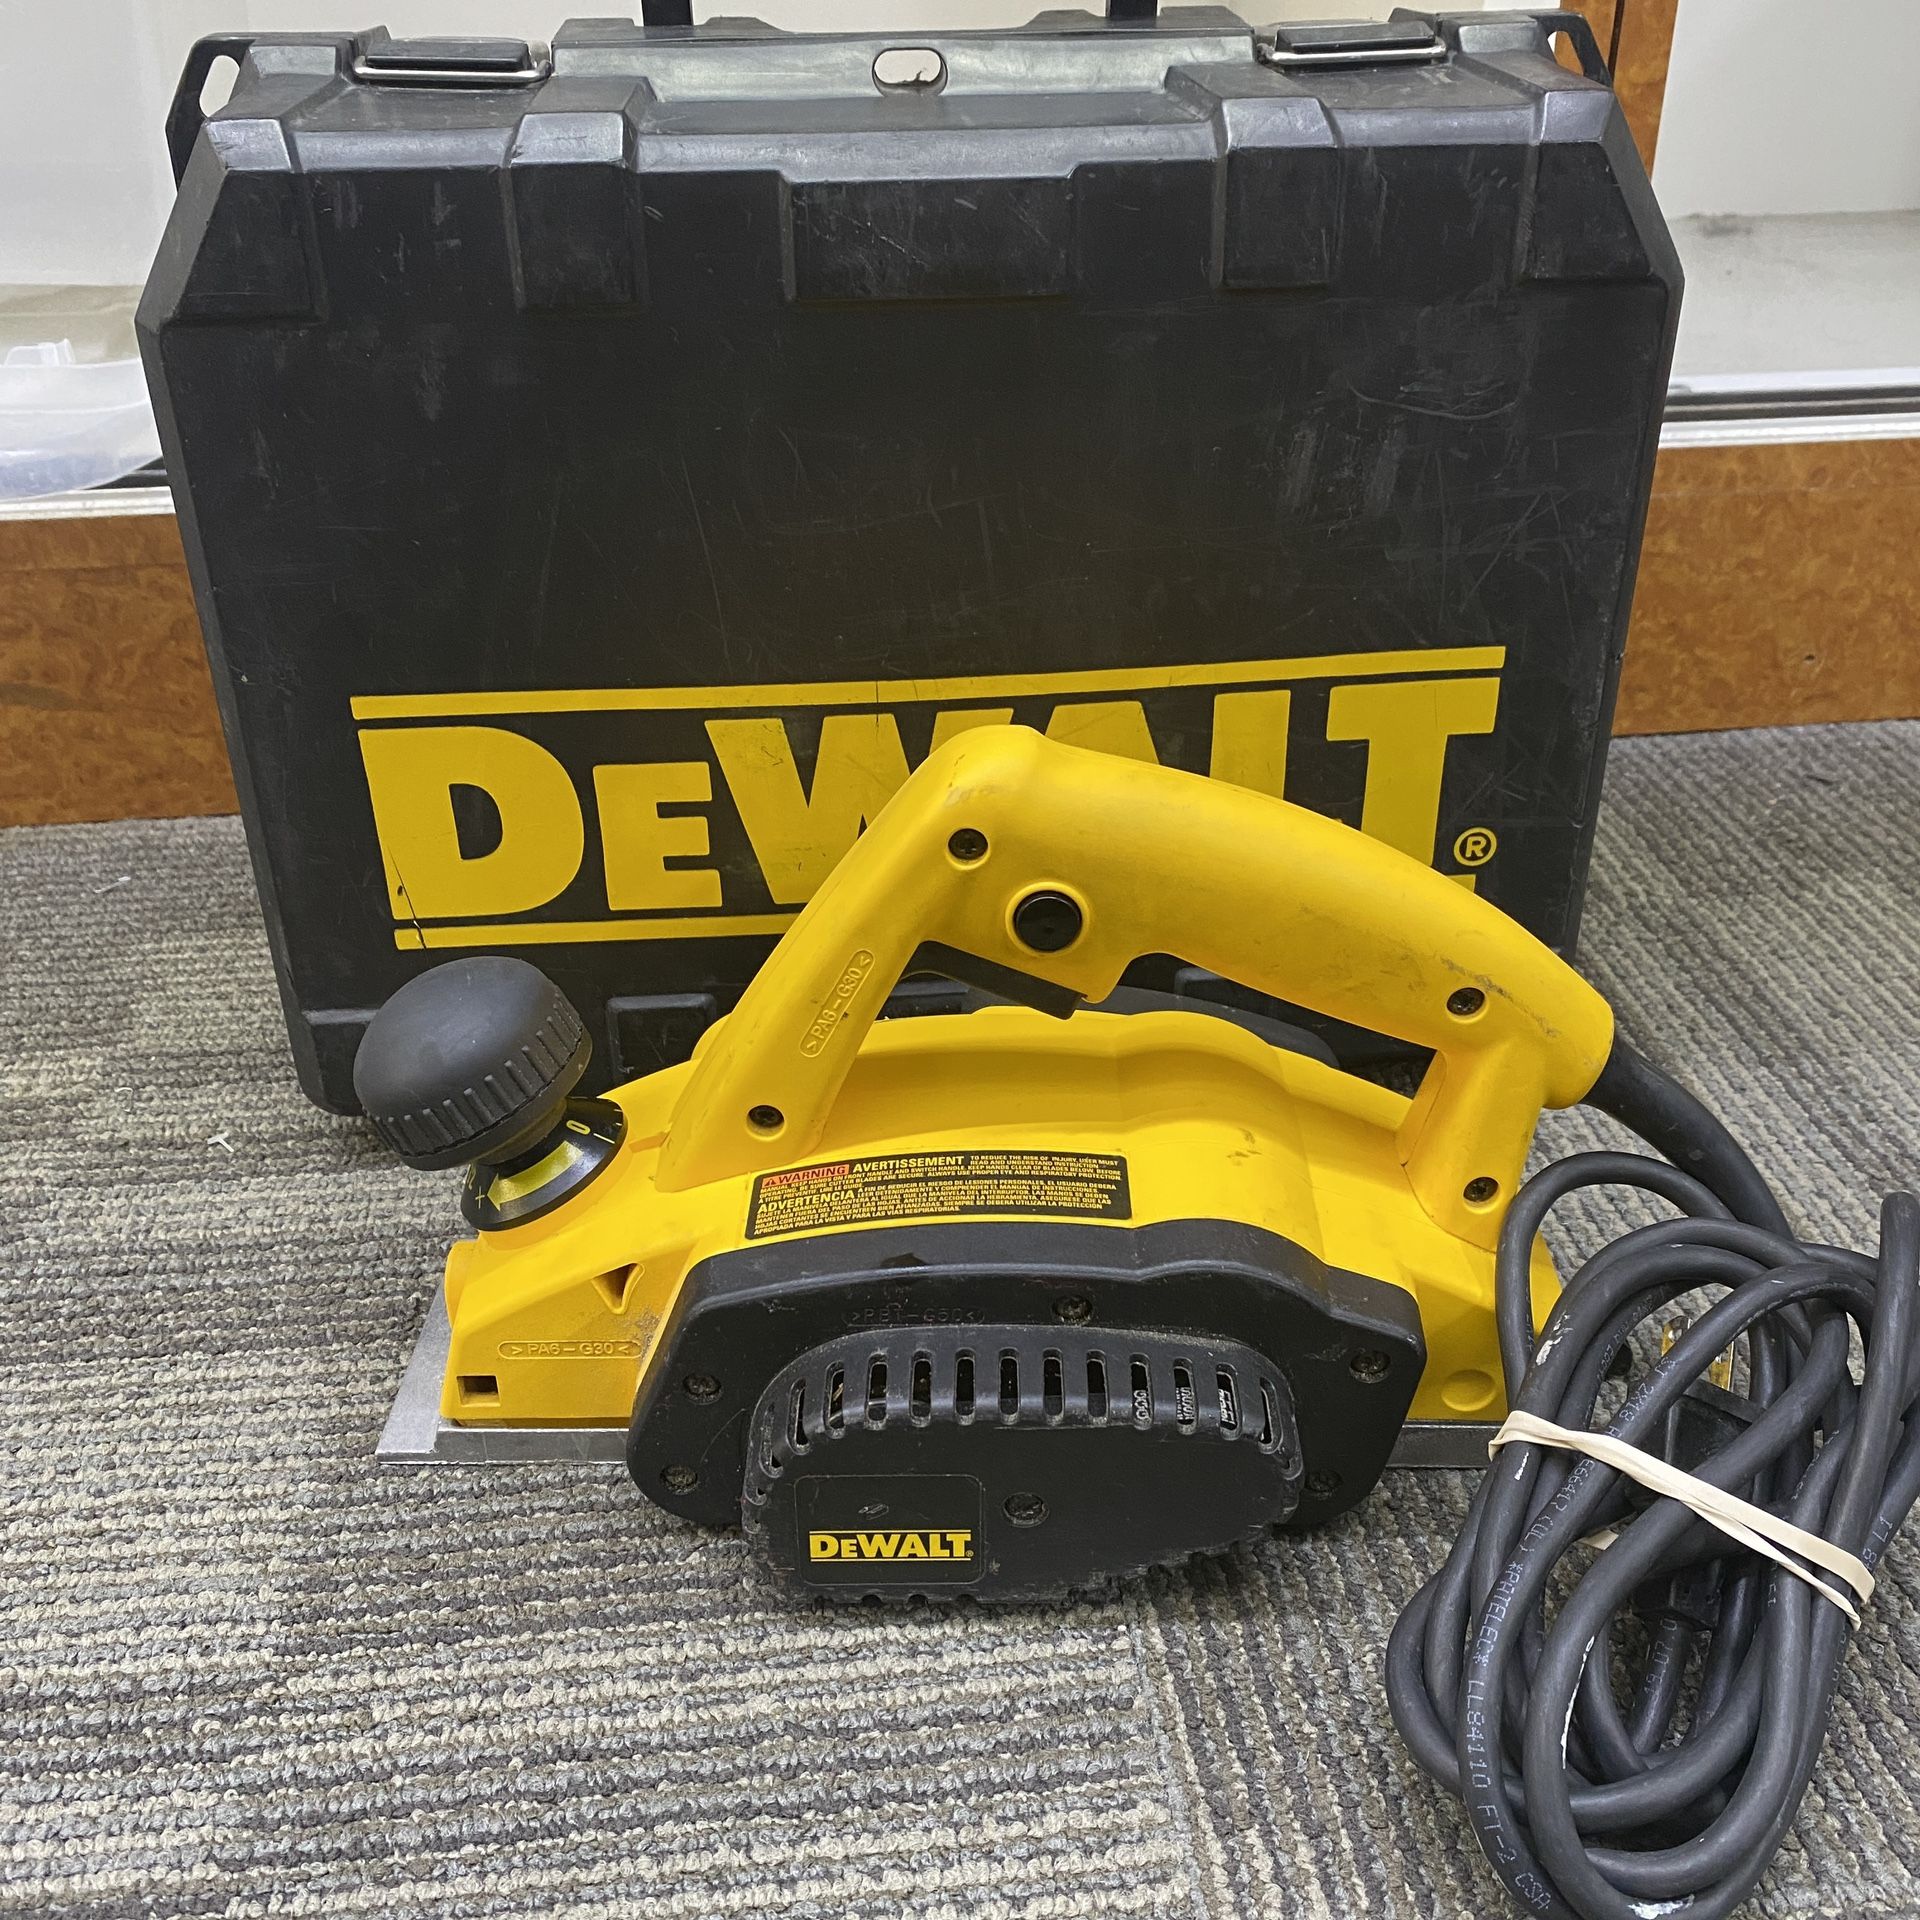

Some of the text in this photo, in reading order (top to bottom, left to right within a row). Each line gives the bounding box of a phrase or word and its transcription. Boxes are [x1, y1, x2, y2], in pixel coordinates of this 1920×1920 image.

[566, 1120, 591, 1135] 0
[779, 1156, 964, 1183] WARNING AVERTISSEMENT
[757, 1190, 855, 1214] ADVERTENCIA
